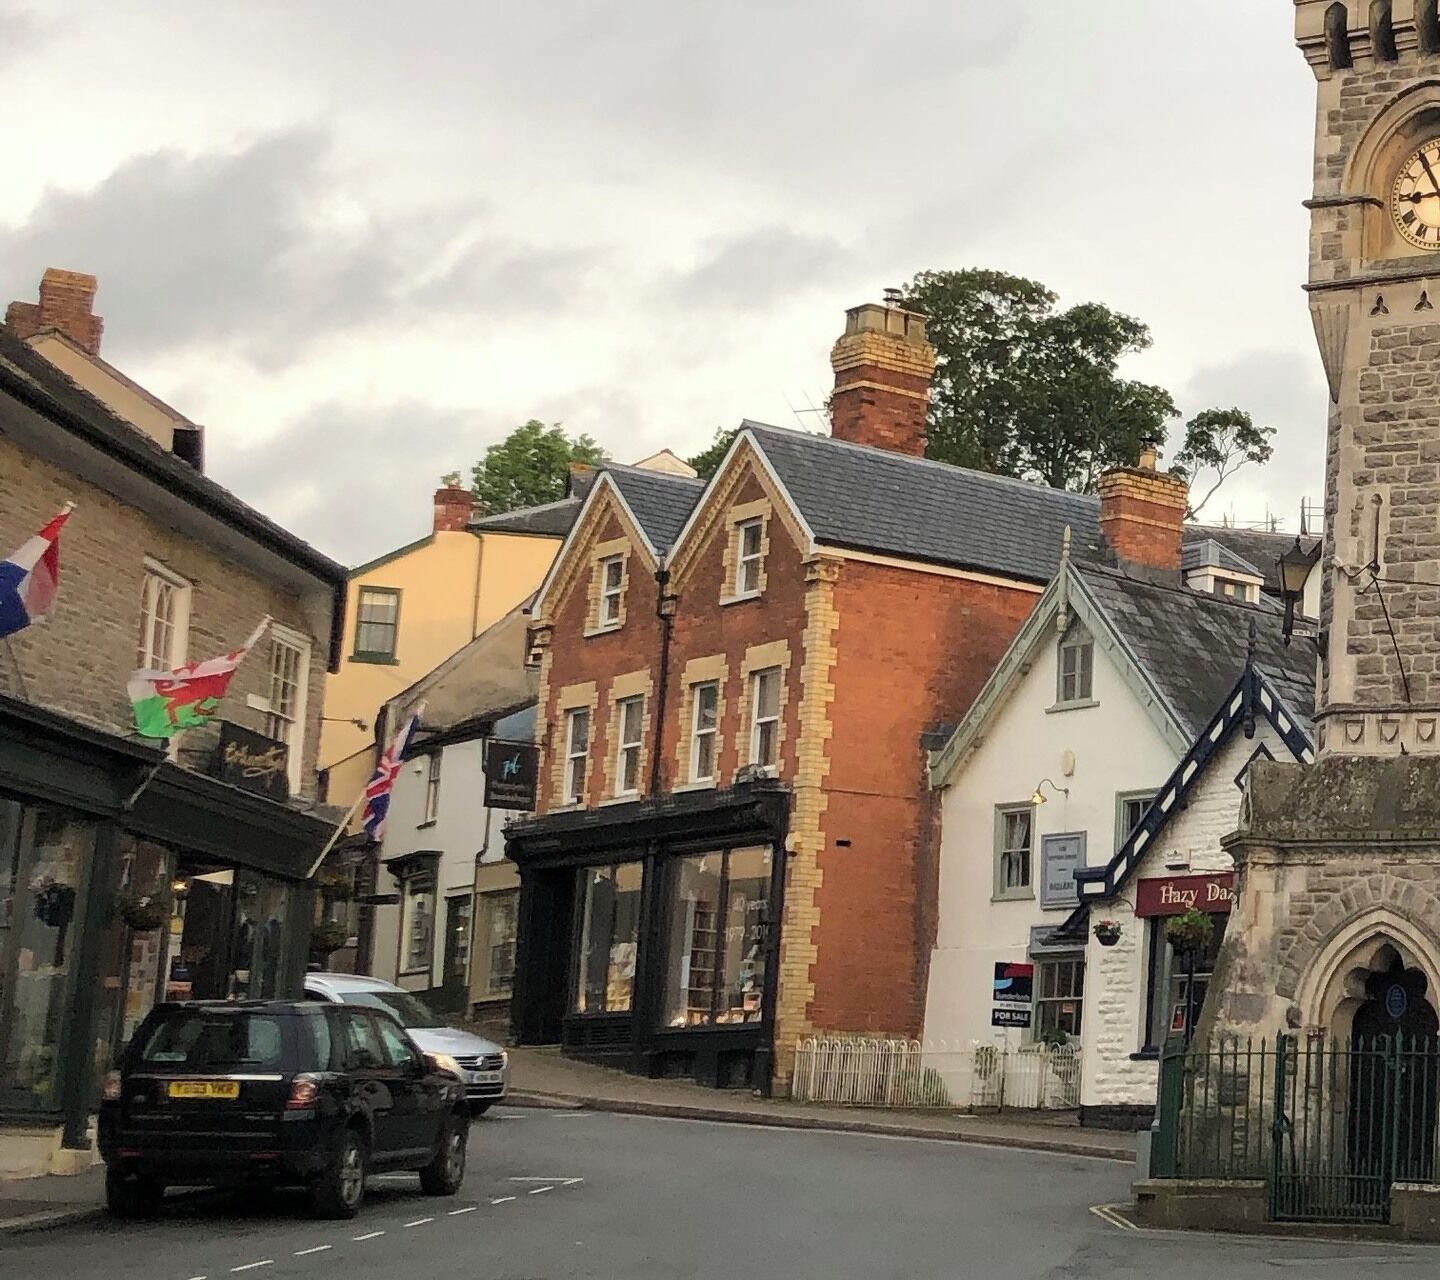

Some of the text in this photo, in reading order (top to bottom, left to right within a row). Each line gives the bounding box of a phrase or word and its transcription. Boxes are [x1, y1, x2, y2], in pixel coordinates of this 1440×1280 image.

[1160, 882, 1199, 908] Hazy
[995, 1011, 1029, 1021] FOR SALE
